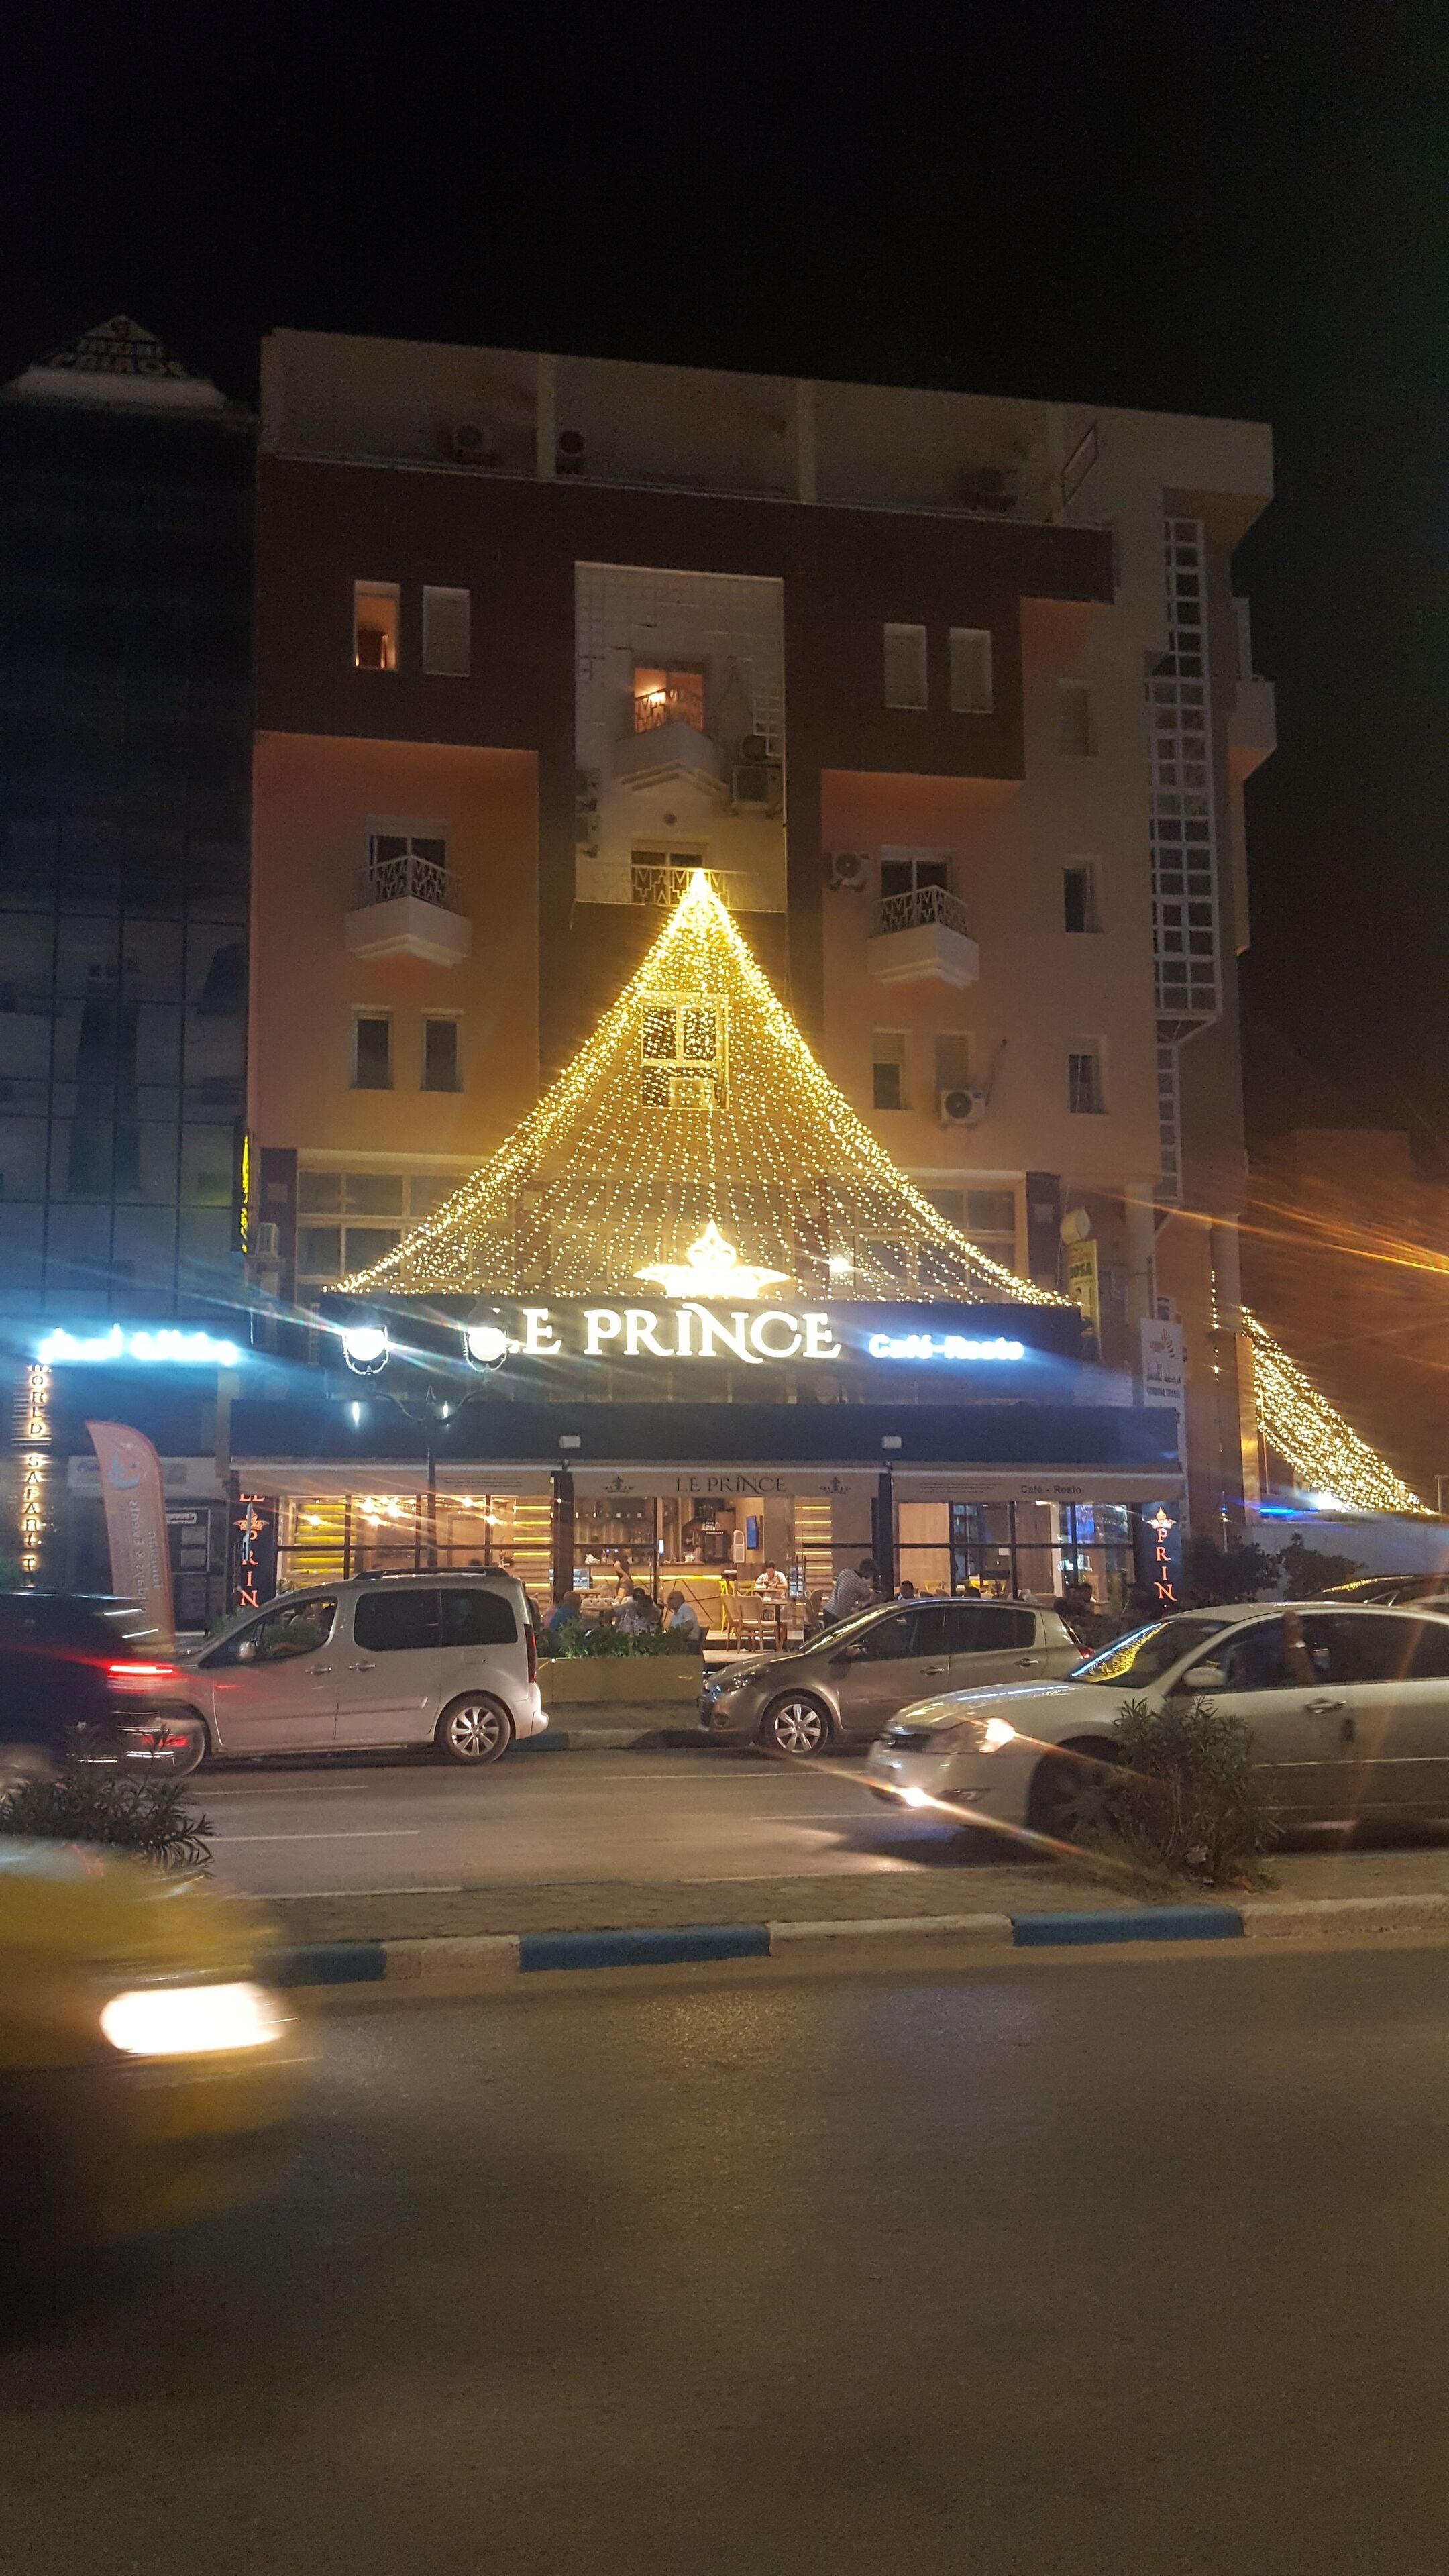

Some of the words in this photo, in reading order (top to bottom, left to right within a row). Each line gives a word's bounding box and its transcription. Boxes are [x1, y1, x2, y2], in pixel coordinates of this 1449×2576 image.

[583, 1302, 841, 1364] PRINCE
[24, 1456, 39, 1546] SAFARI
[676, 1477, 701, 1493] LE
[708, 1475, 787, 1495] PRINCE
